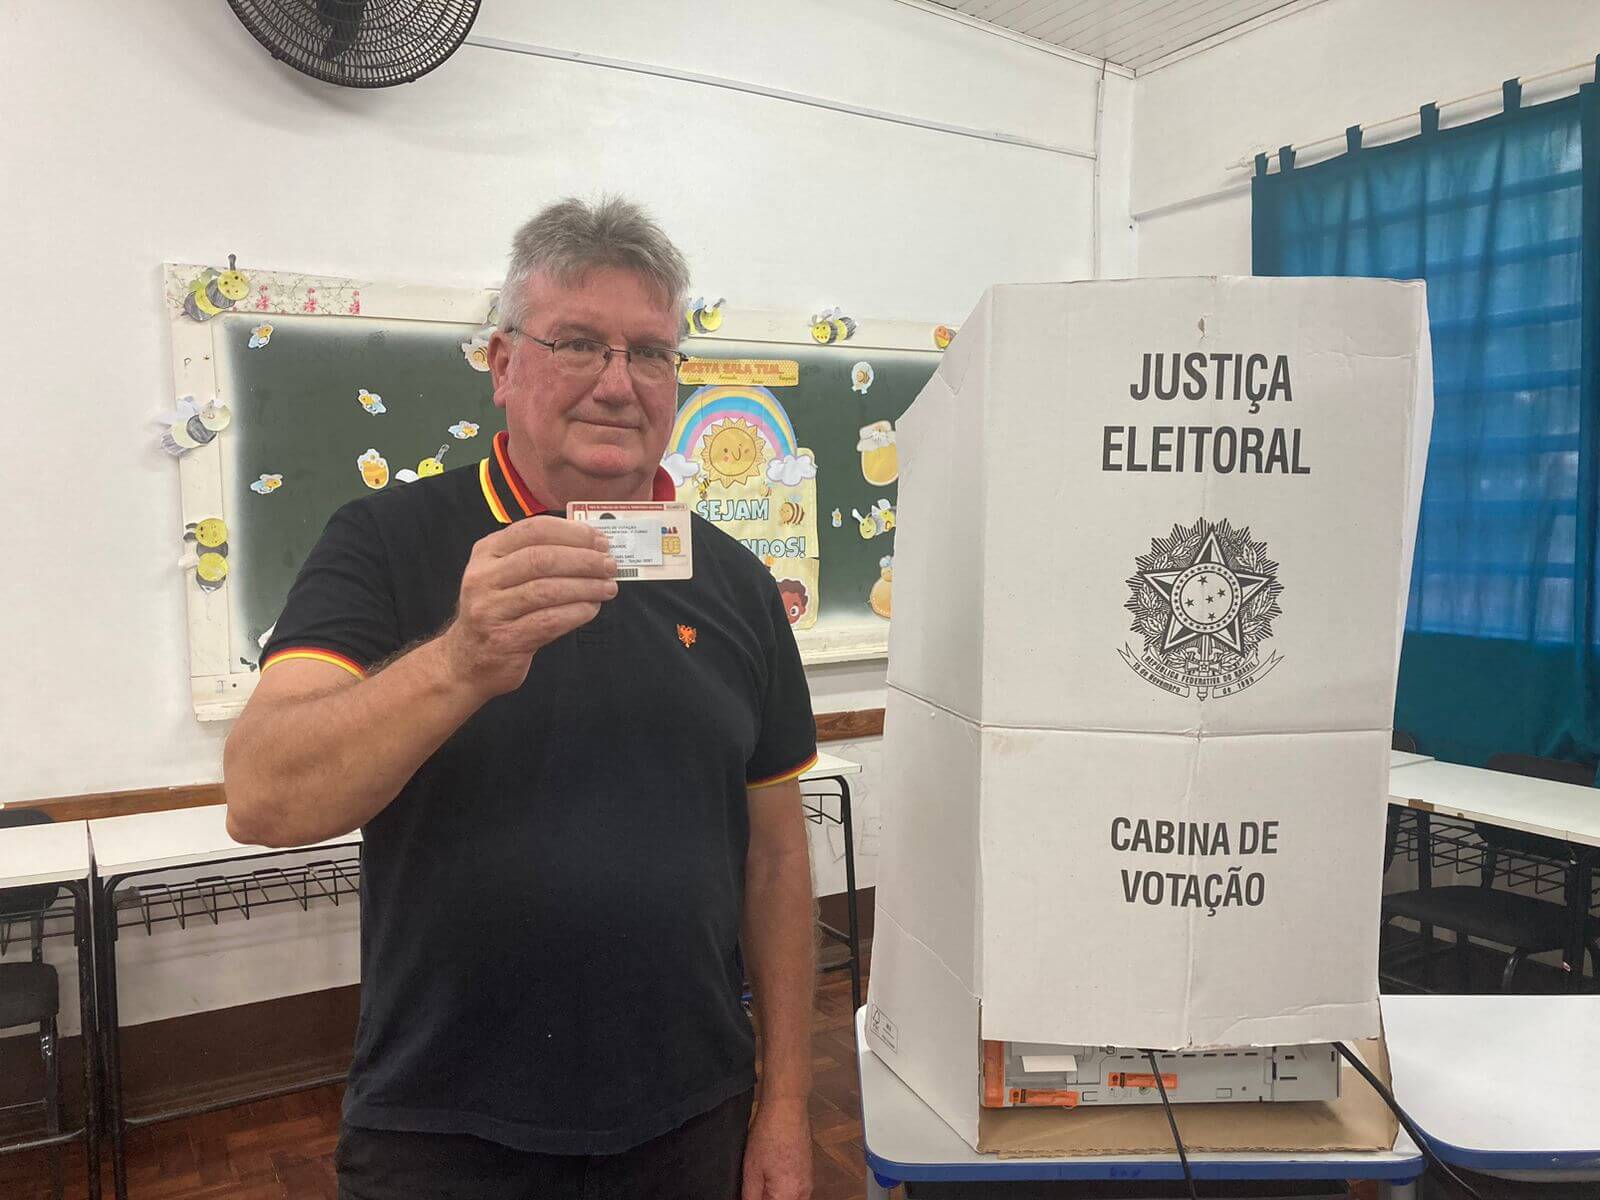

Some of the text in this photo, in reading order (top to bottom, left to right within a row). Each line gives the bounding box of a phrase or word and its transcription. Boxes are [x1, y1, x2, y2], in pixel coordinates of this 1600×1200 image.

[1130, 352, 1293, 415] JUSTIÇA
[1102, 426, 1311, 474] ELEITORAL
[696, 498, 770, 521] SEJAM
[1234, 661, 1256, 677] BRASIL
[1111, 817, 1279, 856] CABINA DE
[1121, 866, 1265, 917] VOTAÇÃO
